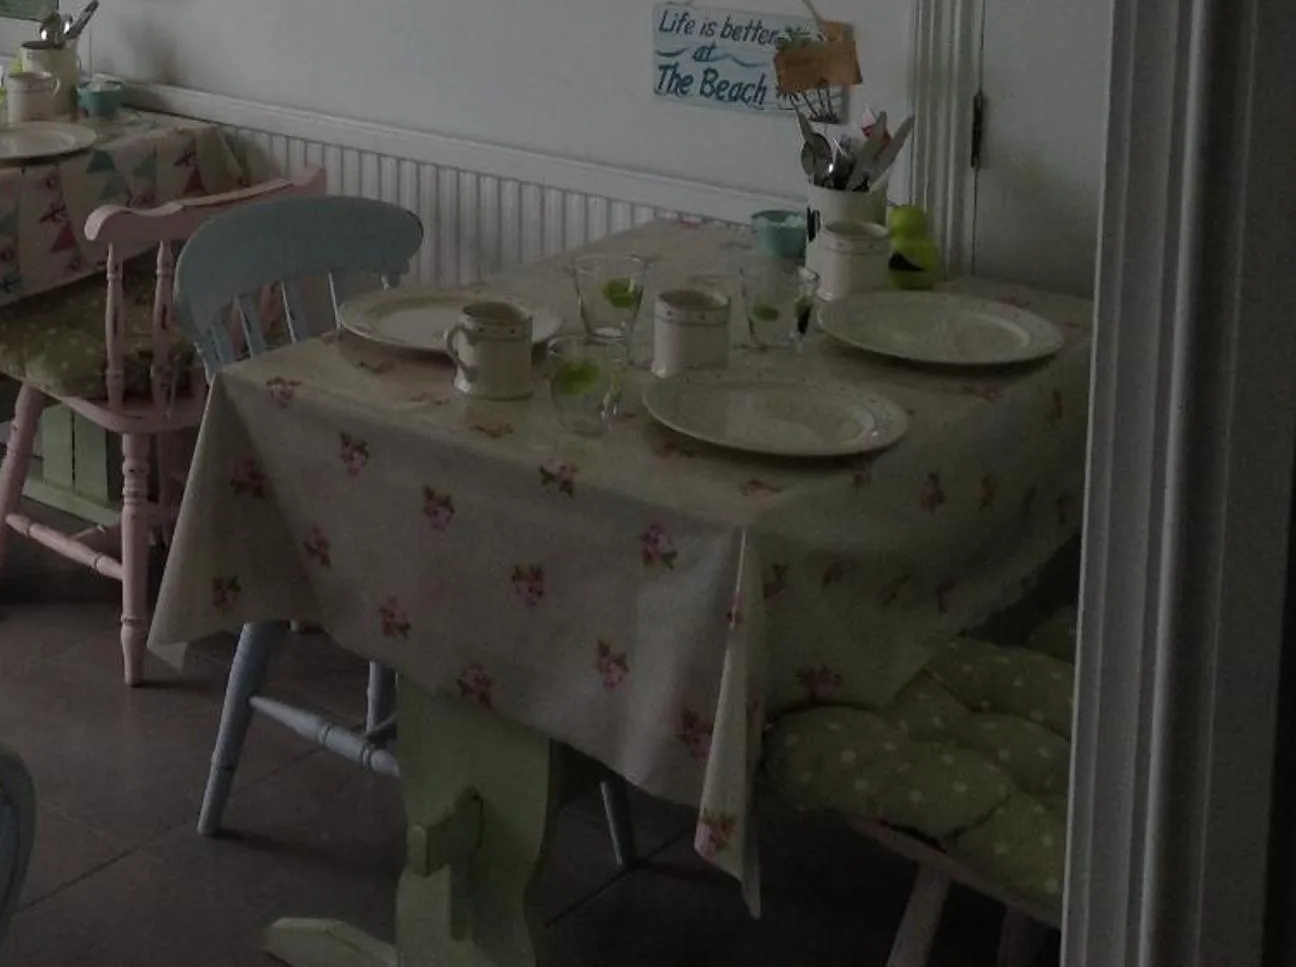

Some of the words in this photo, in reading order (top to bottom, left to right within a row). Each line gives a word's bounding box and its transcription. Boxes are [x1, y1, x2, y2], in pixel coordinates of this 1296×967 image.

[658, 9, 697, 35] Life
[700, 17, 716, 38] is
[719, 14, 779, 46] better
[691, 41, 718, 63] at
[656, 61, 694, 96] The
[699, 65, 769, 106] Beach
